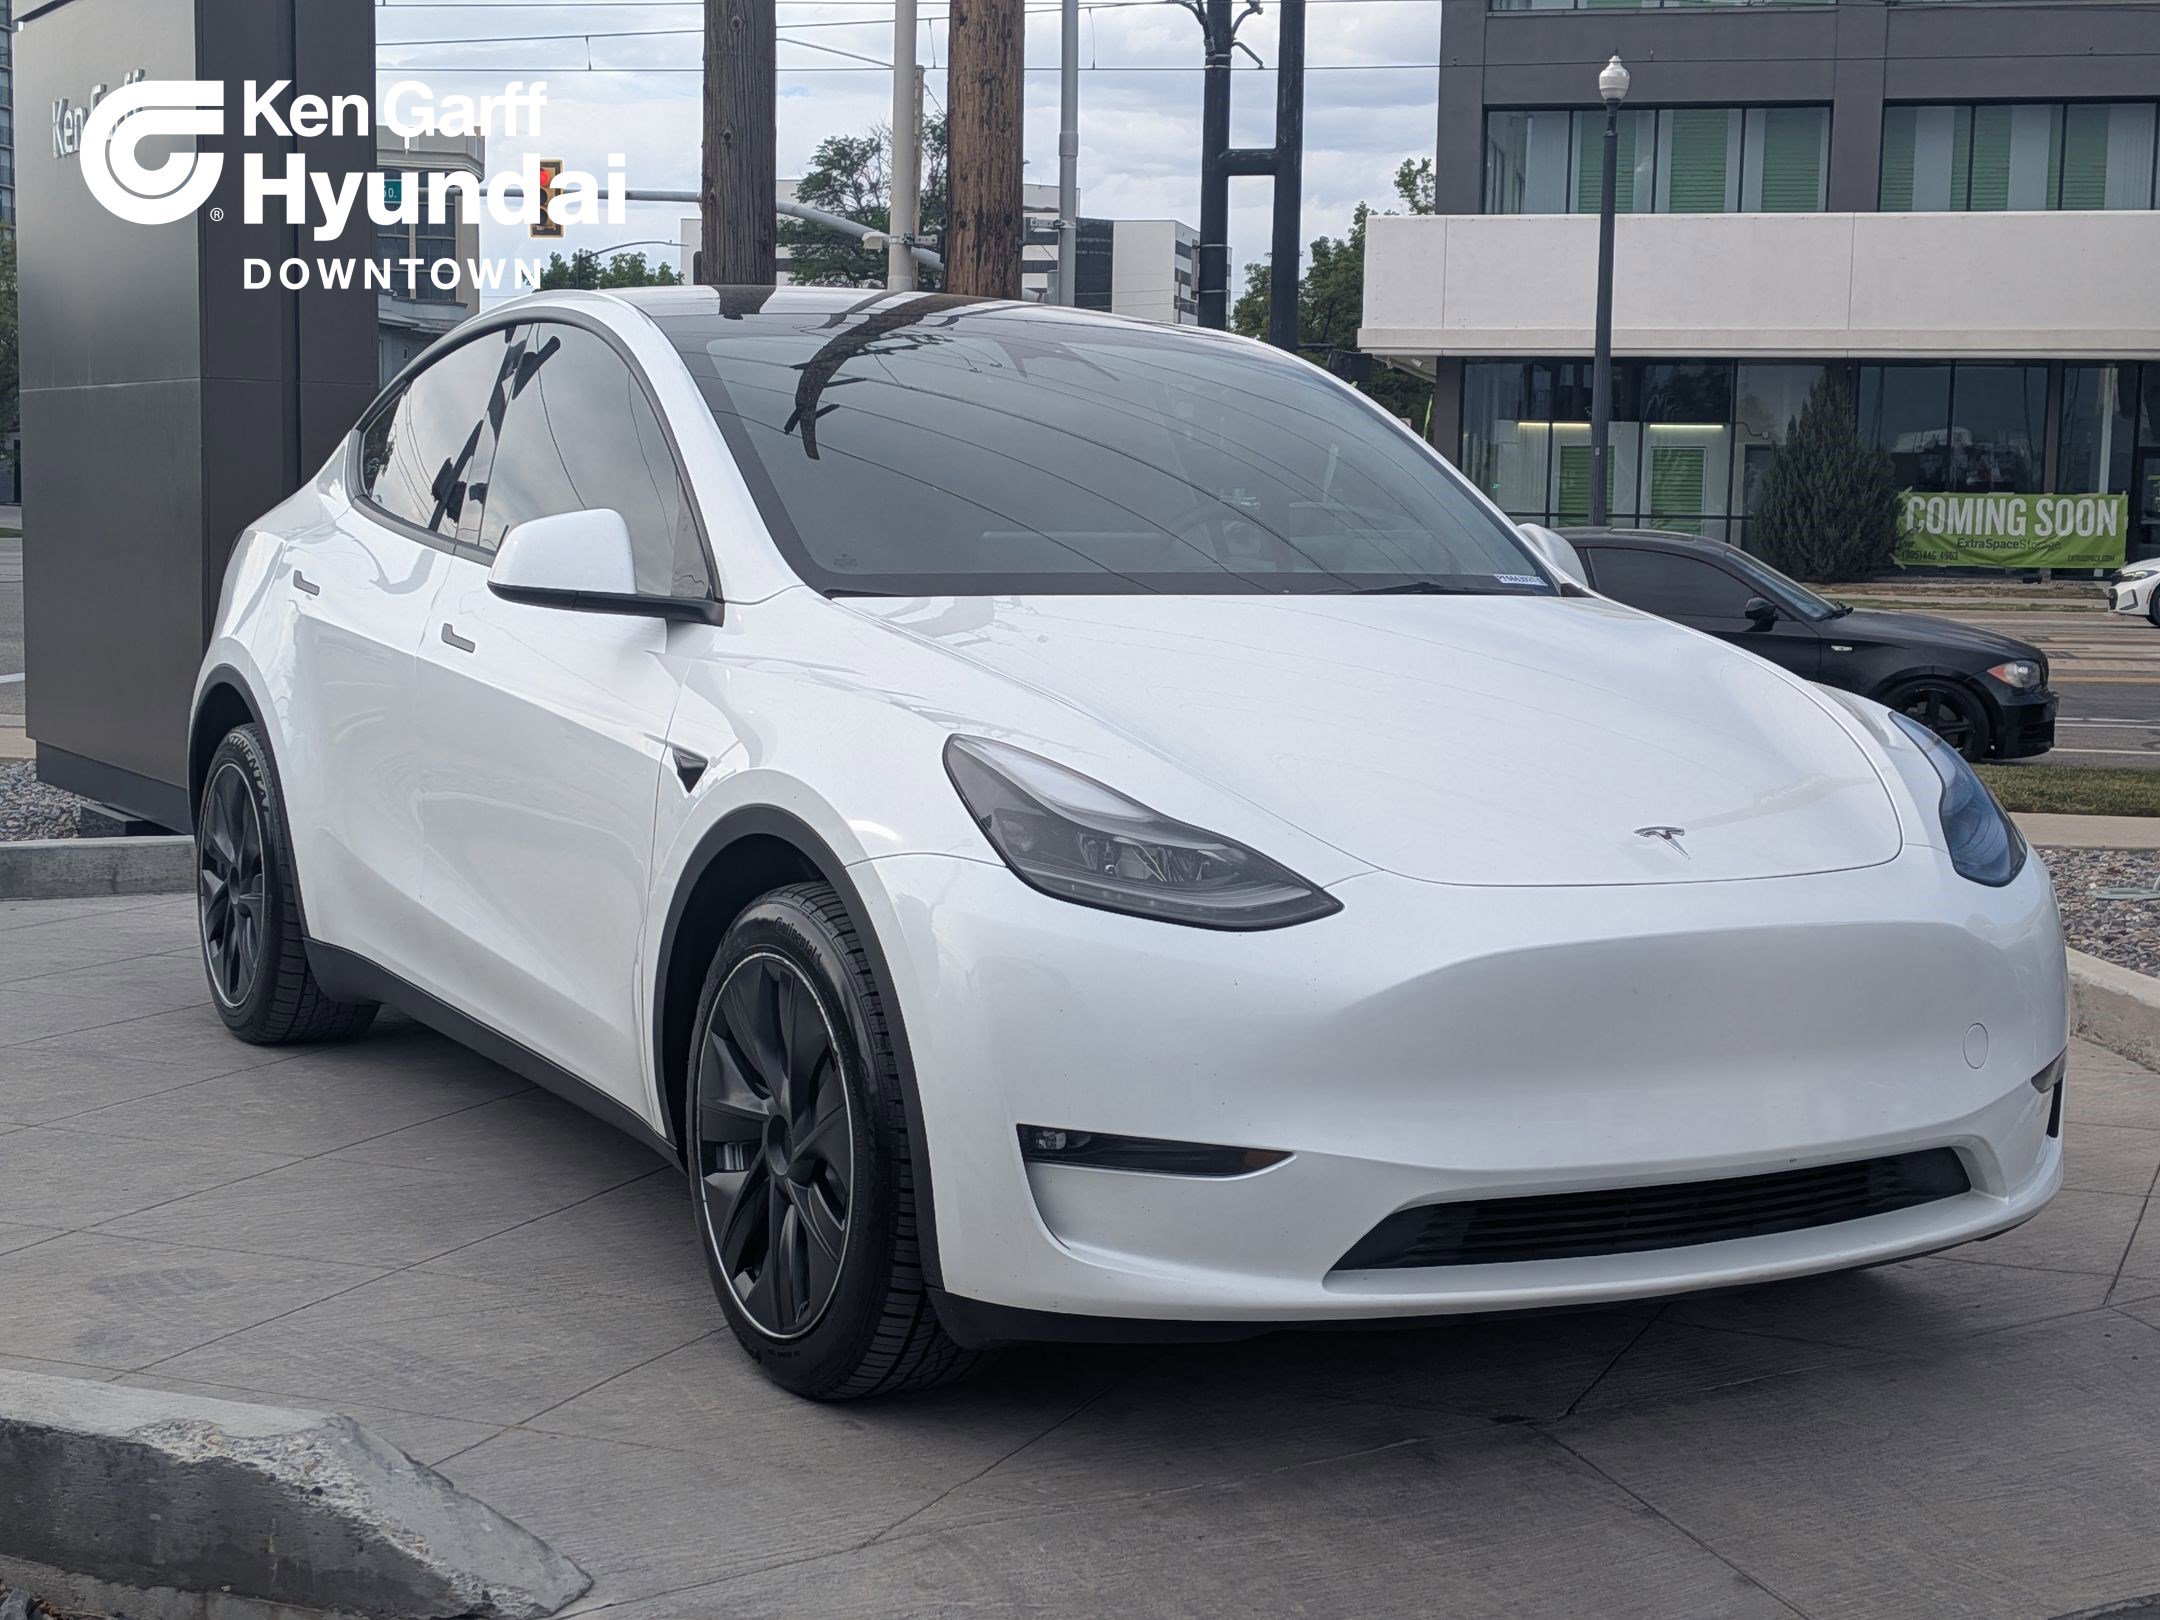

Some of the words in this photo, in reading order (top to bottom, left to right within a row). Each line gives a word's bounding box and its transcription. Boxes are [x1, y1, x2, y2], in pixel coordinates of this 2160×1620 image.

[1906, 496, 2027, 536] COMING
[2034, 498, 2118, 537] SOON
[774, 916, 818, 960] Continental
